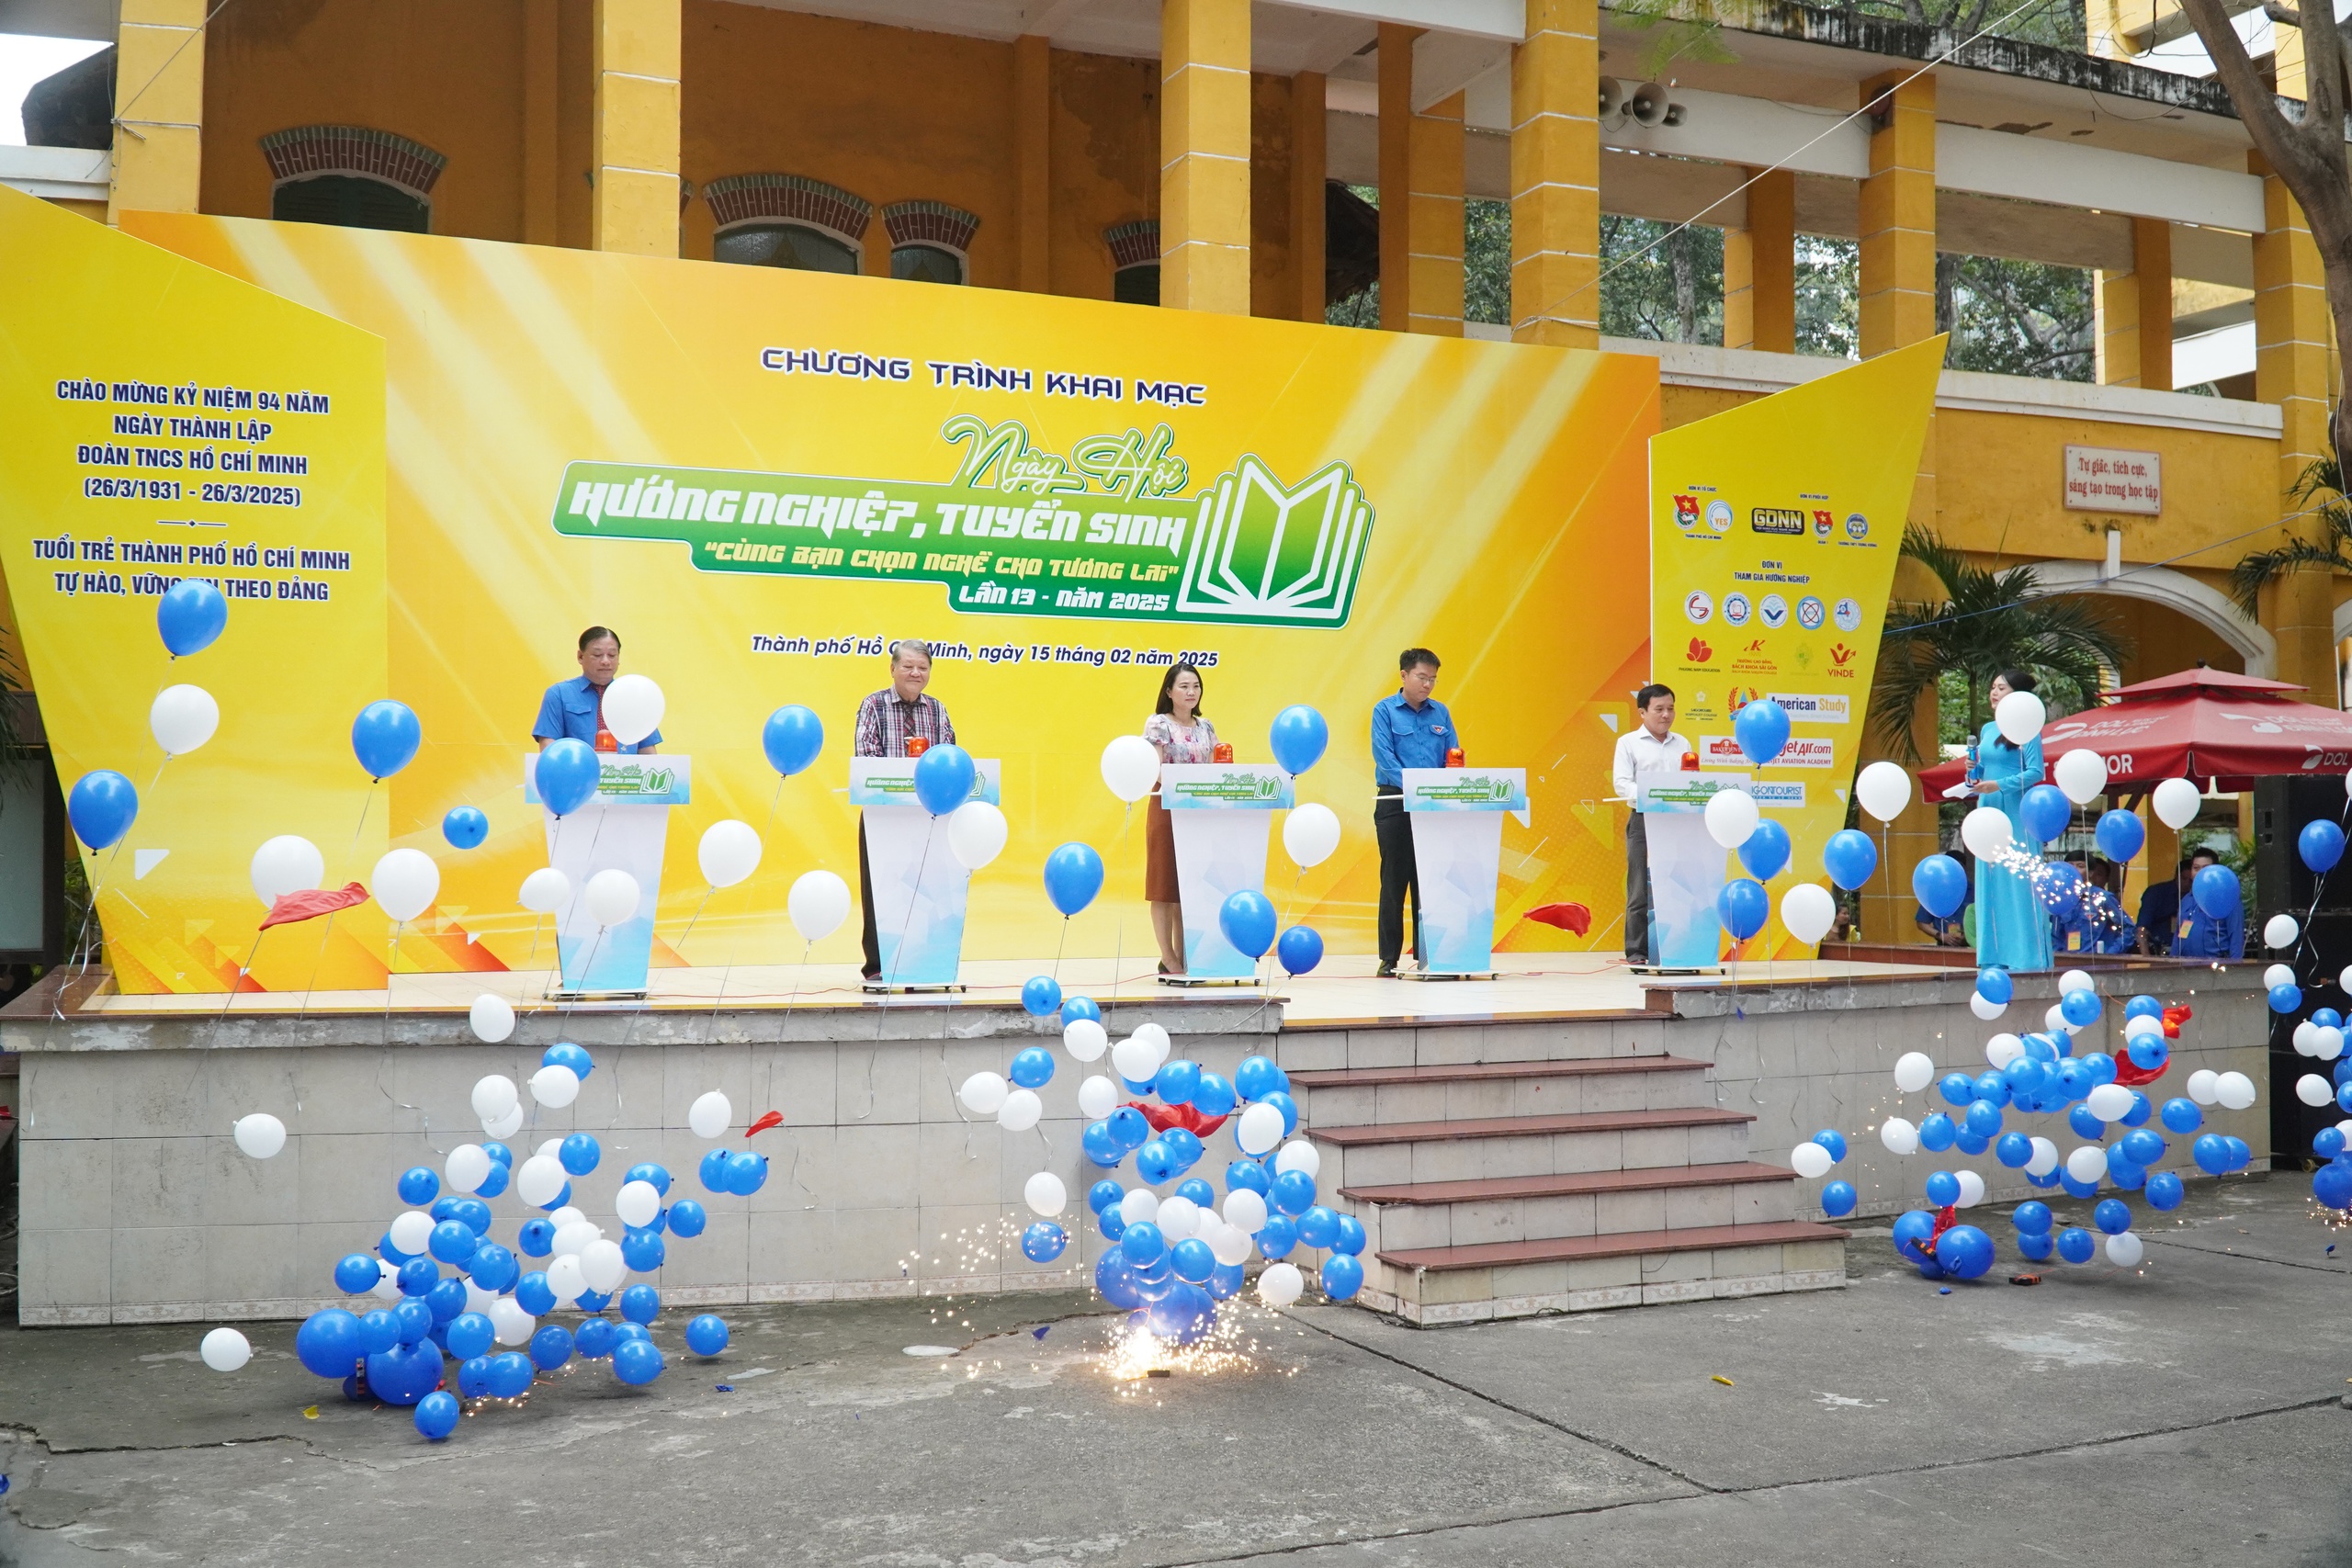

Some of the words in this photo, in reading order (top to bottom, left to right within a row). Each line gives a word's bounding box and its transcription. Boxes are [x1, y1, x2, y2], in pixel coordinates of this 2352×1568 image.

[762, 348, 910, 380] CHƯƠNG
[927, 361, 1031, 391] TRÌNH
[1046, 372, 1122, 400] KHAI
[1137, 382, 1206, 407] MẠC
[57, 378, 107, 401] CHÀO
[113, 380, 167, 404] MỪNG
[174, 381, 198, 406] KỶ
[204, 387, 251, 412] NIỆM
[258, 392, 280, 411] 94
[287, 390, 329, 413] NĂM
[114, 414, 163, 436] NGÀY
[170, 416, 230, 439] THÀNH
[237, 419, 272, 444] LẬP
[78, 444, 129, 466] ĐOÀN
[136, 448, 183, 468] TNCS
[189, 445, 213, 469] HỒ
[220, 450, 251, 471] CHÍ
[258, 455, 307, 474] MINH
[948, 422, 1079, 495] Ngày
[1077, 429, 1181, 503] Hội
[85, 478, 181, 500] (26/3/1931
[201, 483, 300, 507] 26/3/2025)
[2105, 481, 2126, 501] trong
[568, 474, 741, 527] HƯỚNG
[936, 499, 1081, 542] TUYỂN
[1085, 512, 1187, 558] SINH
[1714, 517, 1728, 526] YES
[1753, 509, 1802, 529] GDNN
[33, 533, 74, 559] TUỔI
[81, 536, 115, 561] TRẺ
[121, 539, 182, 563] THÀNH
[189, 539, 226, 565] PHỐ
[232, 542, 257, 568] HỒ
[264, 545, 295, 569] CHÍ
[300, 551, 350, 570] MINH
[791, 546, 843, 570] BẠN
[850, 549, 917, 573] CHỌN
[923, 550, 993, 578] NGHỀ
[995, 556, 1043, 580] CHO
[55, 571, 79, 597] TỰ
[84, 572, 125, 596] HÀO,
[225, 579, 271, 599] THEO
[277, 575, 328, 600] ĐẢNG
[1735, 571, 1751, 581] THAM
[958, 581, 1008, 604] LẦN
[1011, 588, 1036, 605] 13
[1056, 586, 1104, 608] NĂM
[1109, 593, 1170, 611] 2025
[752, 636, 808, 654] Thành
[815, 637, 854, 656] phố
[857, 636, 883, 655] Hồ
[927, 642, 972, 660] Minh,
[979, 646, 1024, 662] ngày
[1030, 646, 1050, 661] 15
[1056, 646, 1104, 666] tháng
[1109, 649, 1130, 664] 02
[1136, 649, 1173, 665] năm
[1178, 651, 1218, 666] 2025
[1827, 669, 1854, 678] VINDE
[1819, 698, 1847, 714] Study
[2324, 752, 2348, 766] DOL
